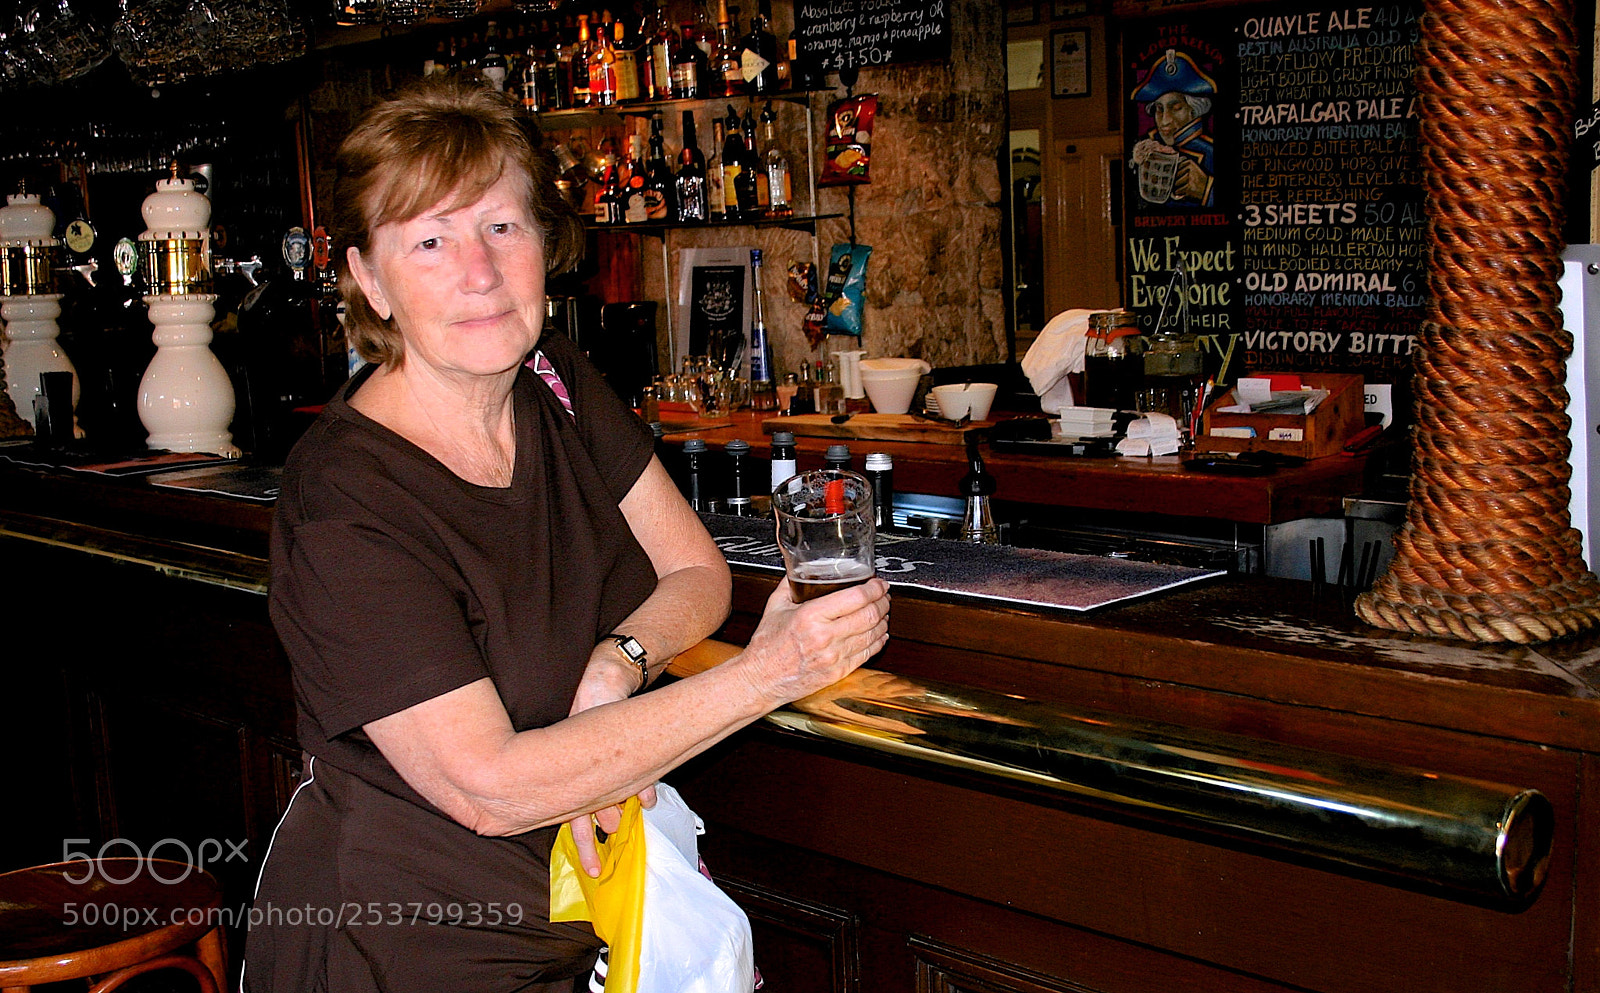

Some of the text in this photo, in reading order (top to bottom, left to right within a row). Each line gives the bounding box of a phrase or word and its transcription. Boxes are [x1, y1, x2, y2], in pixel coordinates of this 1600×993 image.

[869, 8, 924, 29] raspberry
[930, 0, 945, 18] OR
[1243, 12, 1321, 39] QUAYLE
[1327, 7, 1373, 32] ALE
[1157, 24, 1189, 37] THE
[1139, 35, 1225, 66] LORD NELSON
[1240, 45, 1415, 73] PALE YELLOW PREDOMI
[1240, 73, 1276, 89] LIGHT
[1278, 69, 1329, 87] BODIED
[1332, 67, 1372, 83] CRISP
[1240, 88, 1270, 104] BEST
[1275, 85, 1314, 101] WHEAT
[1318, 85, 1331, 98] IN
[1335, 80, 1406, 98] AUSTRALIA
[1240, 101, 1351, 126] TRAFALGAR
[1356, 98, 1405, 120] PALE
[1241, 126, 1313, 142] HONORARY
[1317, 124, 1381, 140] MENTION
[1241, 141, 1308, 159] BRONZED
[1312, 140, 1360, 157] BITTER
[1364, 139, 1396, 154] PALE
[1241, 158, 1259, 173] OF
[1340, 156, 1376, 171] HOPS
[1380, 155, 1411, 171] GIVE
[1241, 174, 1266, 189] THE
[1268, 172, 1343, 189] BITTERNESS
[1348, 172, 1394, 187] LEVEL
[1240, 187, 1384, 205] BEER REFRESHING
[1134, 213, 1230, 228] BREWERY HOTEL
[1243, 227, 1300, 242] MEDIUM
[1304, 226, 1344, 242] GOLD
[1351, 226, 1395, 242] MADE
[1129, 235, 1237, 278] We Expect
[1242, 244, 1259, 257] IN
[1262, 243, 1302, 257] MIND
[1310, 242, 1395, 257] HALLERTAU
[1243, 258, 1278, 271] FULL
[1279, 257, 1331, 272] BODIED
[1344, 258, 1404, 273] CREAMY
[1244, 271, 1289, 292] OLD
[1294, 271, 1397, 293] ADMIRAL
[1243, 293, 1316, 307] HONORARY
[1321, 292, 1380, 307] MENTION
[1184, 313, 1232, 330] HEIR
[1244, 329, 1342, 353] VICTORY
